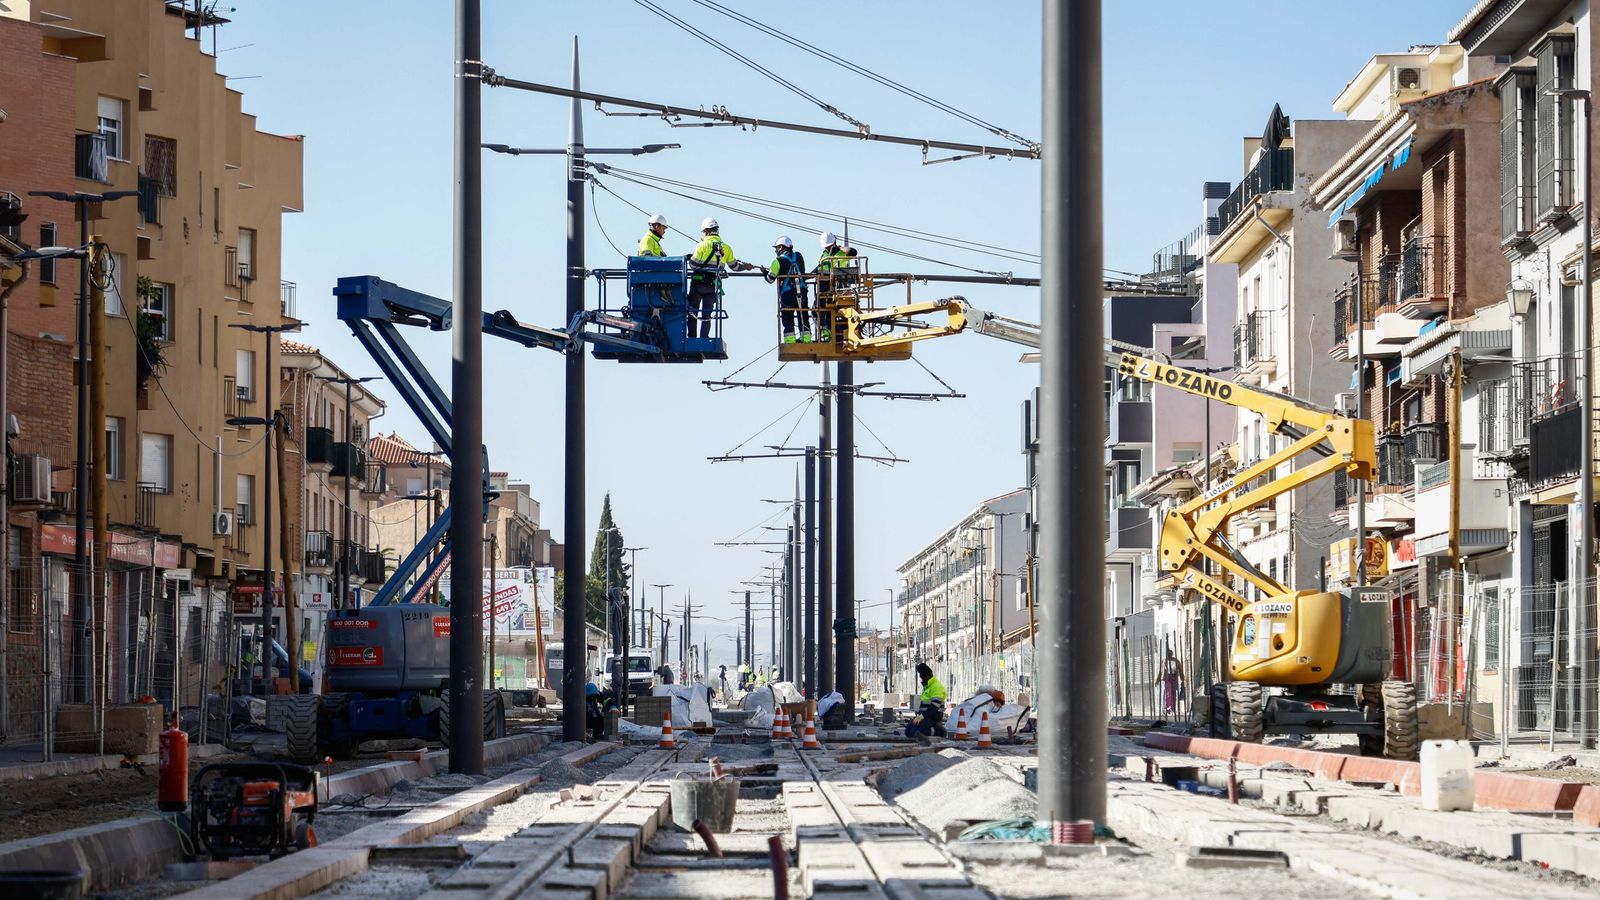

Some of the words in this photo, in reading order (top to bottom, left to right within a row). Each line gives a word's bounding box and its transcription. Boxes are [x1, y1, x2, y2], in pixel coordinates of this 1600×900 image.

[1154, 364, 1232, 400] LOZANO
[1209, 480, 1234, 497] LOZANO
[485, 571, 516, 579] ABERTI
[1197, 578, 1244, 612] LOZANO
[1261, 604, 1292, 612] LOZANO
